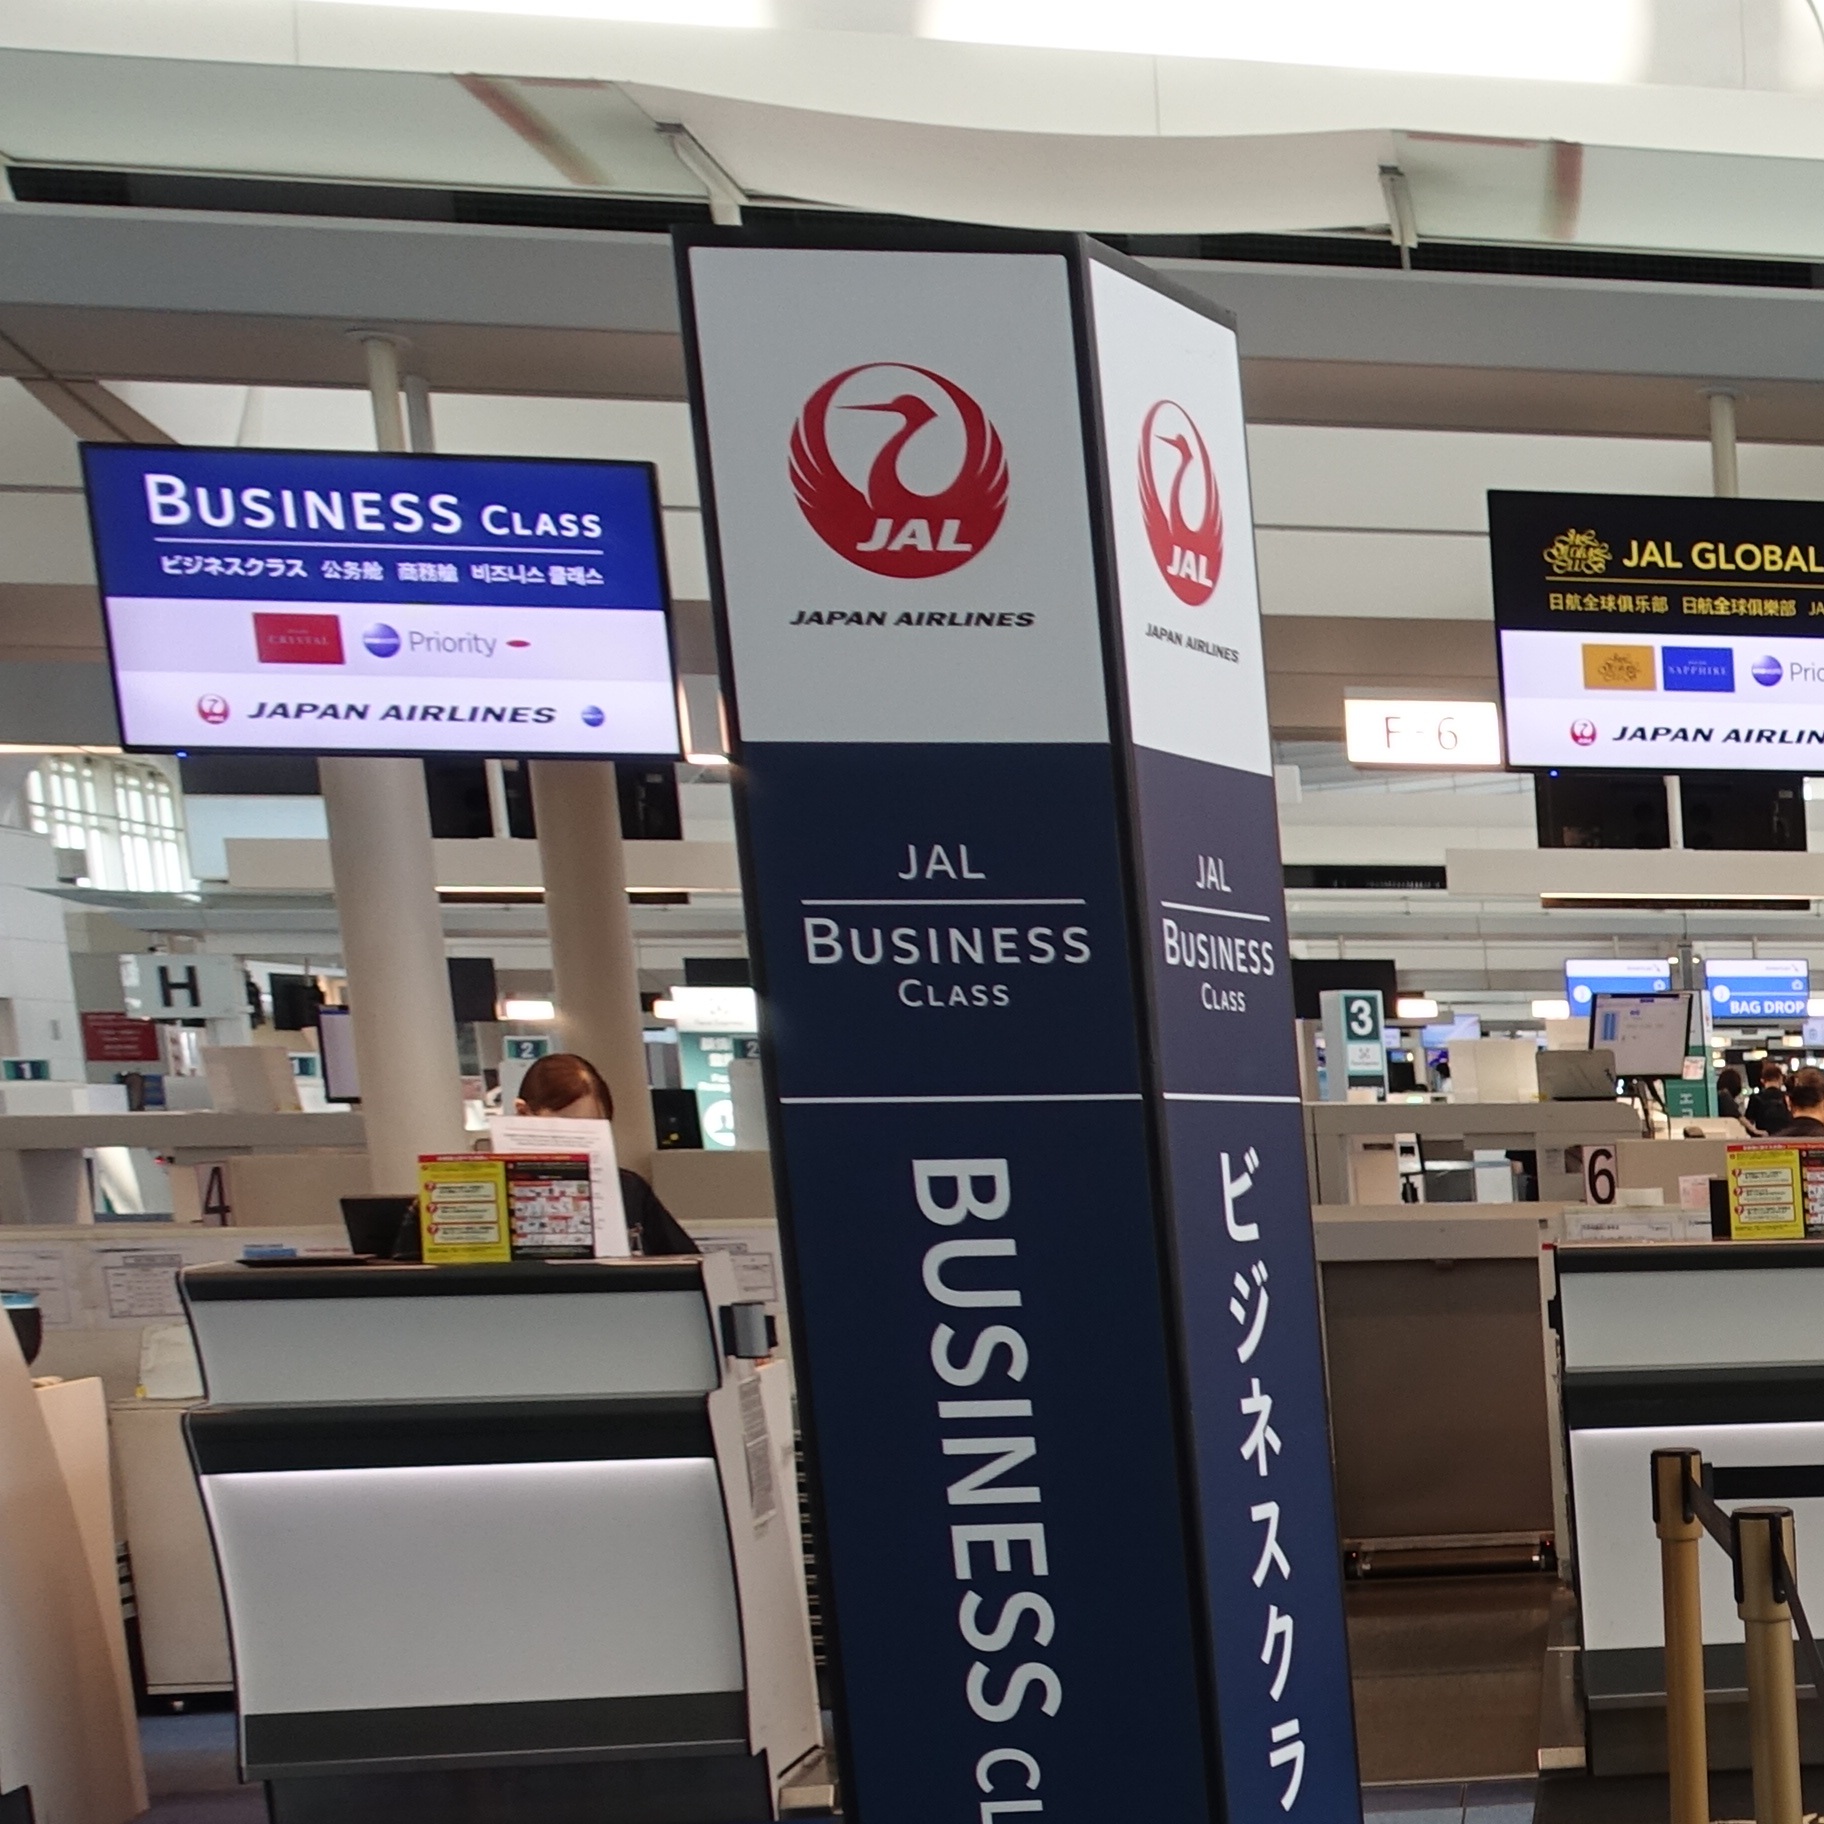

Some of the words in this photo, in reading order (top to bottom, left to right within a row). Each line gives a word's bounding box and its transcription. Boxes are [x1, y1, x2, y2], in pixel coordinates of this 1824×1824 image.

[144, 472, 462, 535] BUSINESS
[480, 504, 602, 538] CLASS
[856, 516, 974, 553] JAL
[160, 554, 308, 579] ビジネスクラス
[1166, 543, 1214, 588] JAL
[1622, 539, 1683, 569] JAL
[789, 609, 887, 628] JAPAN
[892, 609, 1036, 629] AIRLINES
[409, 630, 497, 658] Priority
[1145, 622, 1184, 650] JAPAN
[1185, 633, 1240, 664] AIRLINES
[248, 700, 369, 721] JAPAN
[379, 703, 557, 725] AIRLINES
[1612, 725, 1715, 743] JAPAN
[898, 842, 987, 881] JAL
[1195, 854, 1233, 895] JAL
[803, 916, 1092, 967] BUSINESS
[1162, 916, 1276, 978] BUSINESS
[158, 965, 201, 1008] H
[899, 978, 1011, 1008] CLASS
[1201, 981, 1247, 1015] CLASS
[1350, 999, 1374, 1036] 3
[1730, 1000, 1761, 1014] BAG
[1764, 1000, 1805, 1014] DROP
[519, 1041, 534, 1059] 2
[1587, 1148, 1617, 1206] 6
[204, 1166, 231, 1227] 4
[911, 1157, 1063, 1724] BUSINESS
